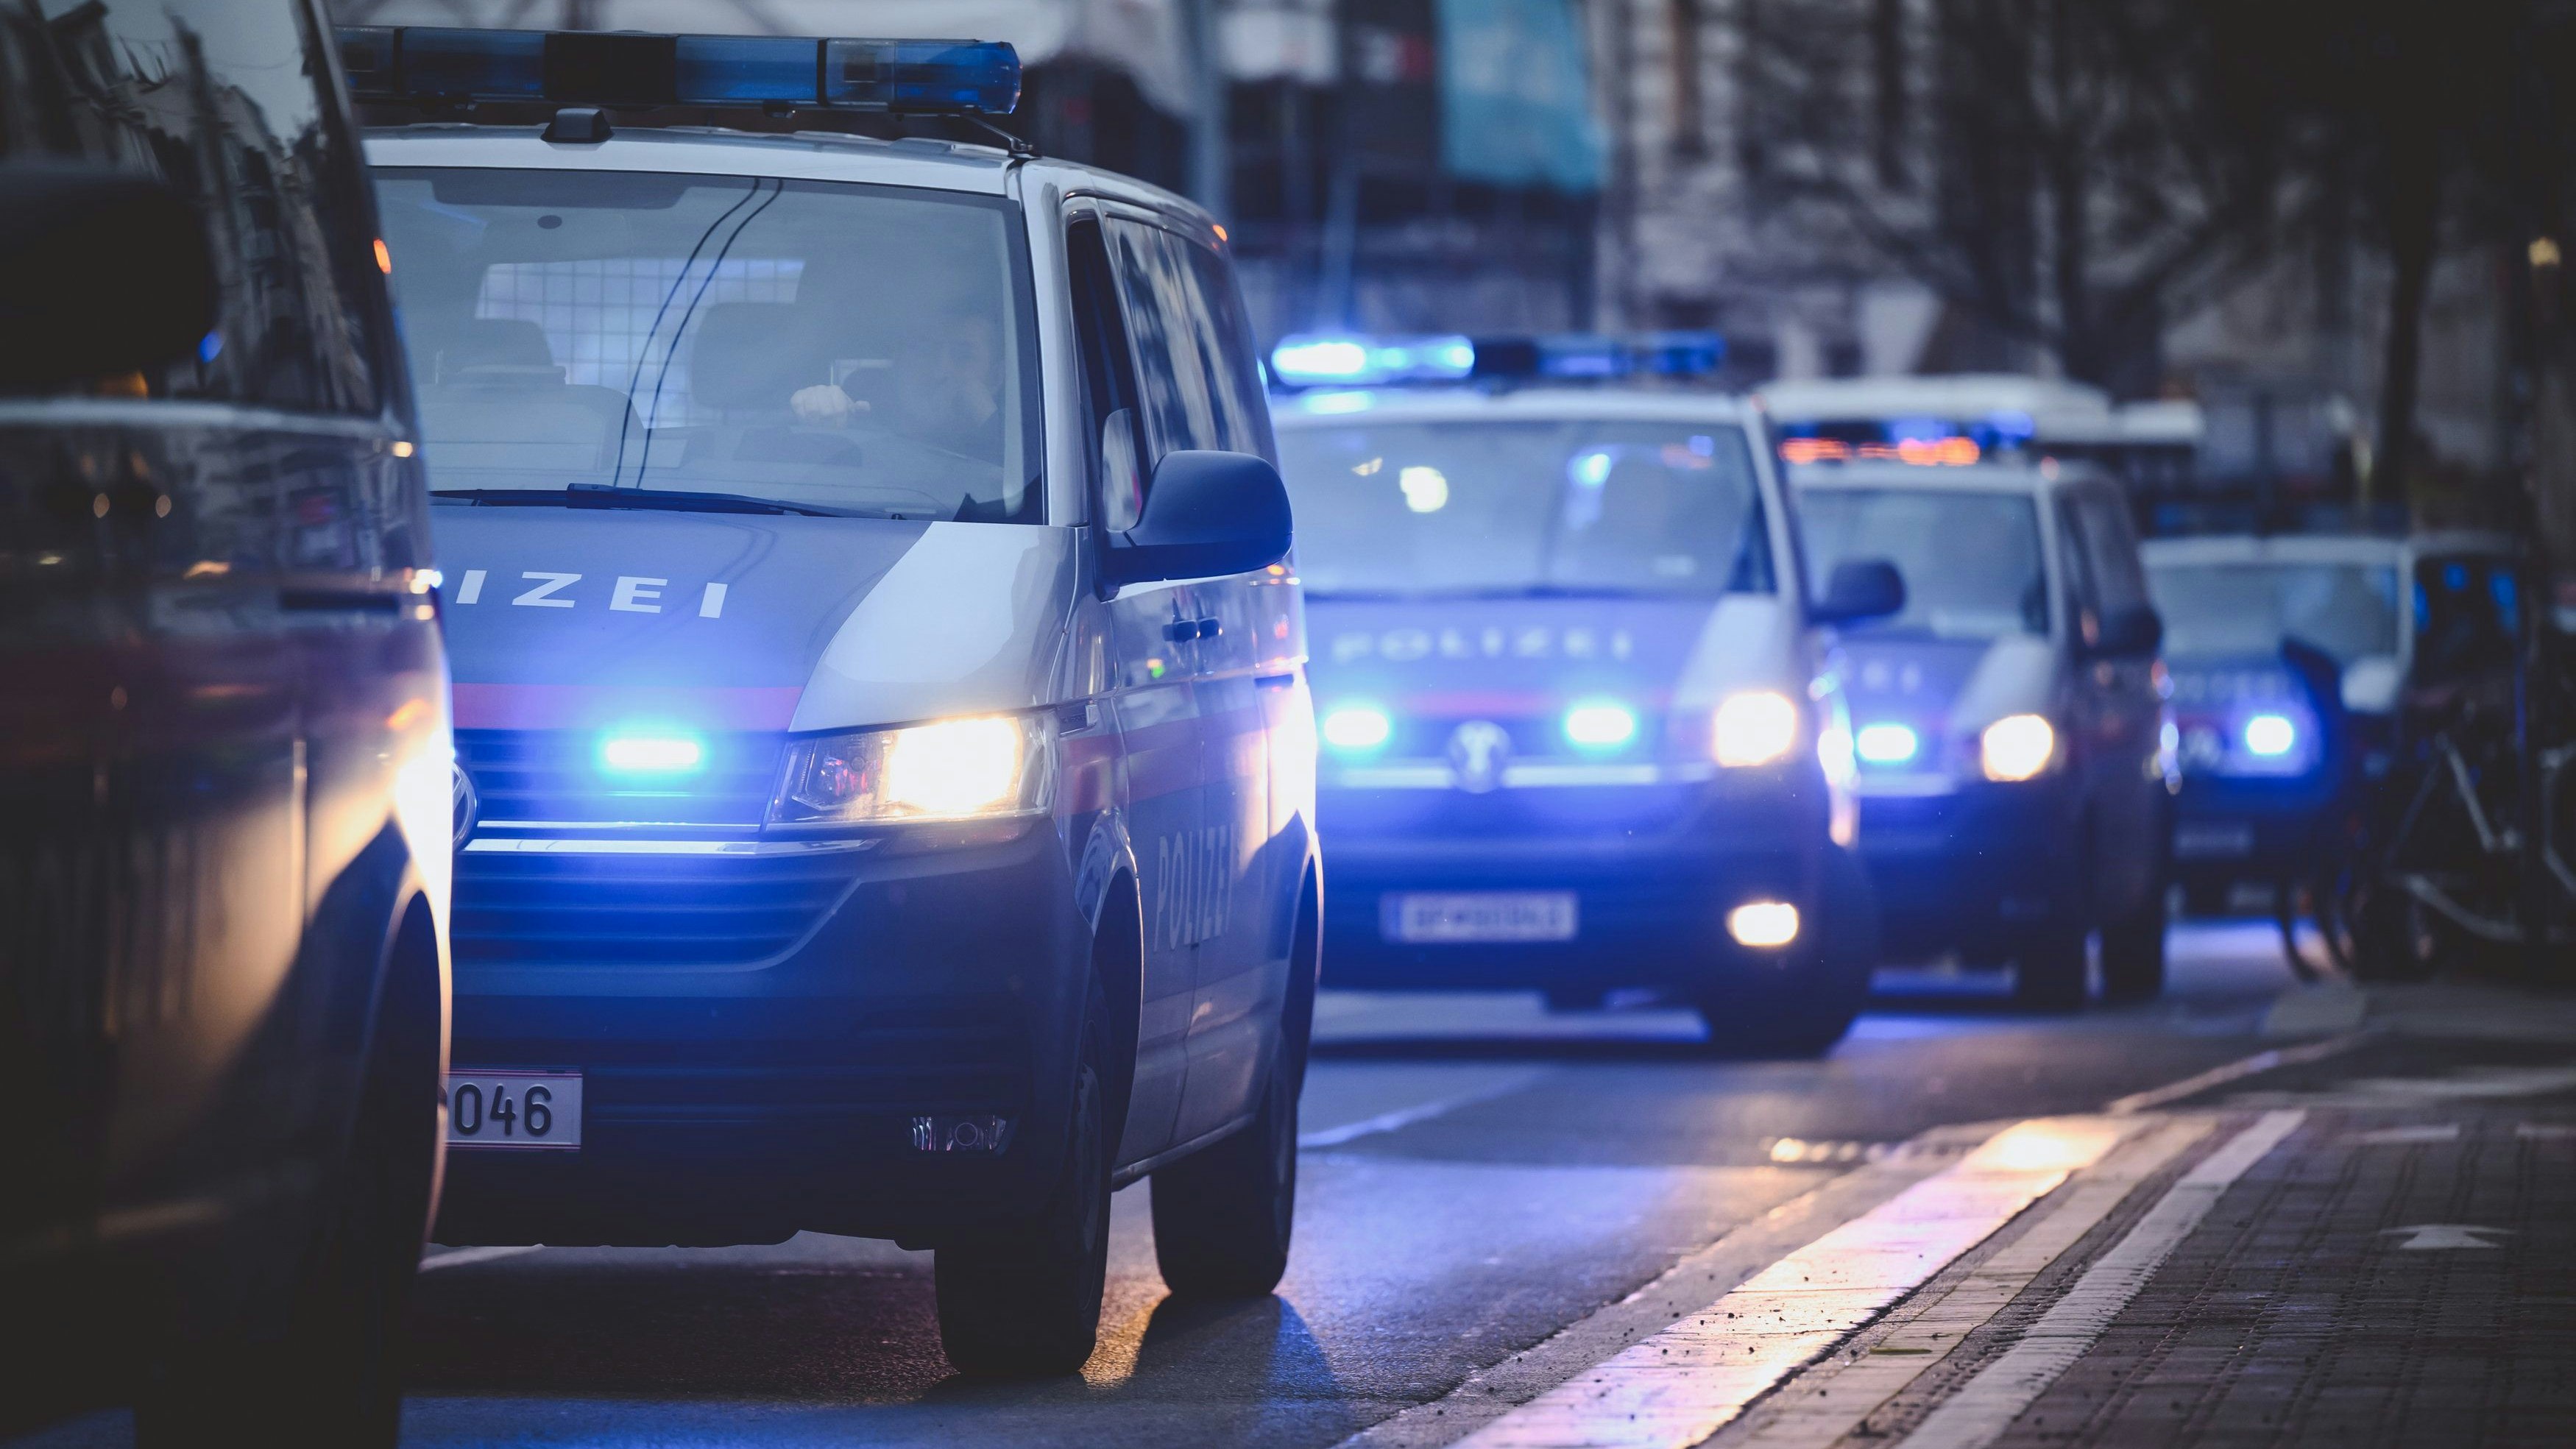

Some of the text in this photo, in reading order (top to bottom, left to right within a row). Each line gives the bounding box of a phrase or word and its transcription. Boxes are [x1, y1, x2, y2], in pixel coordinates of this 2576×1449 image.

[455, 569, 728, 619] IZEI
[1153, 823, 1234, 953] POLIZEI
[453, 1082, 552, 1136] 046
